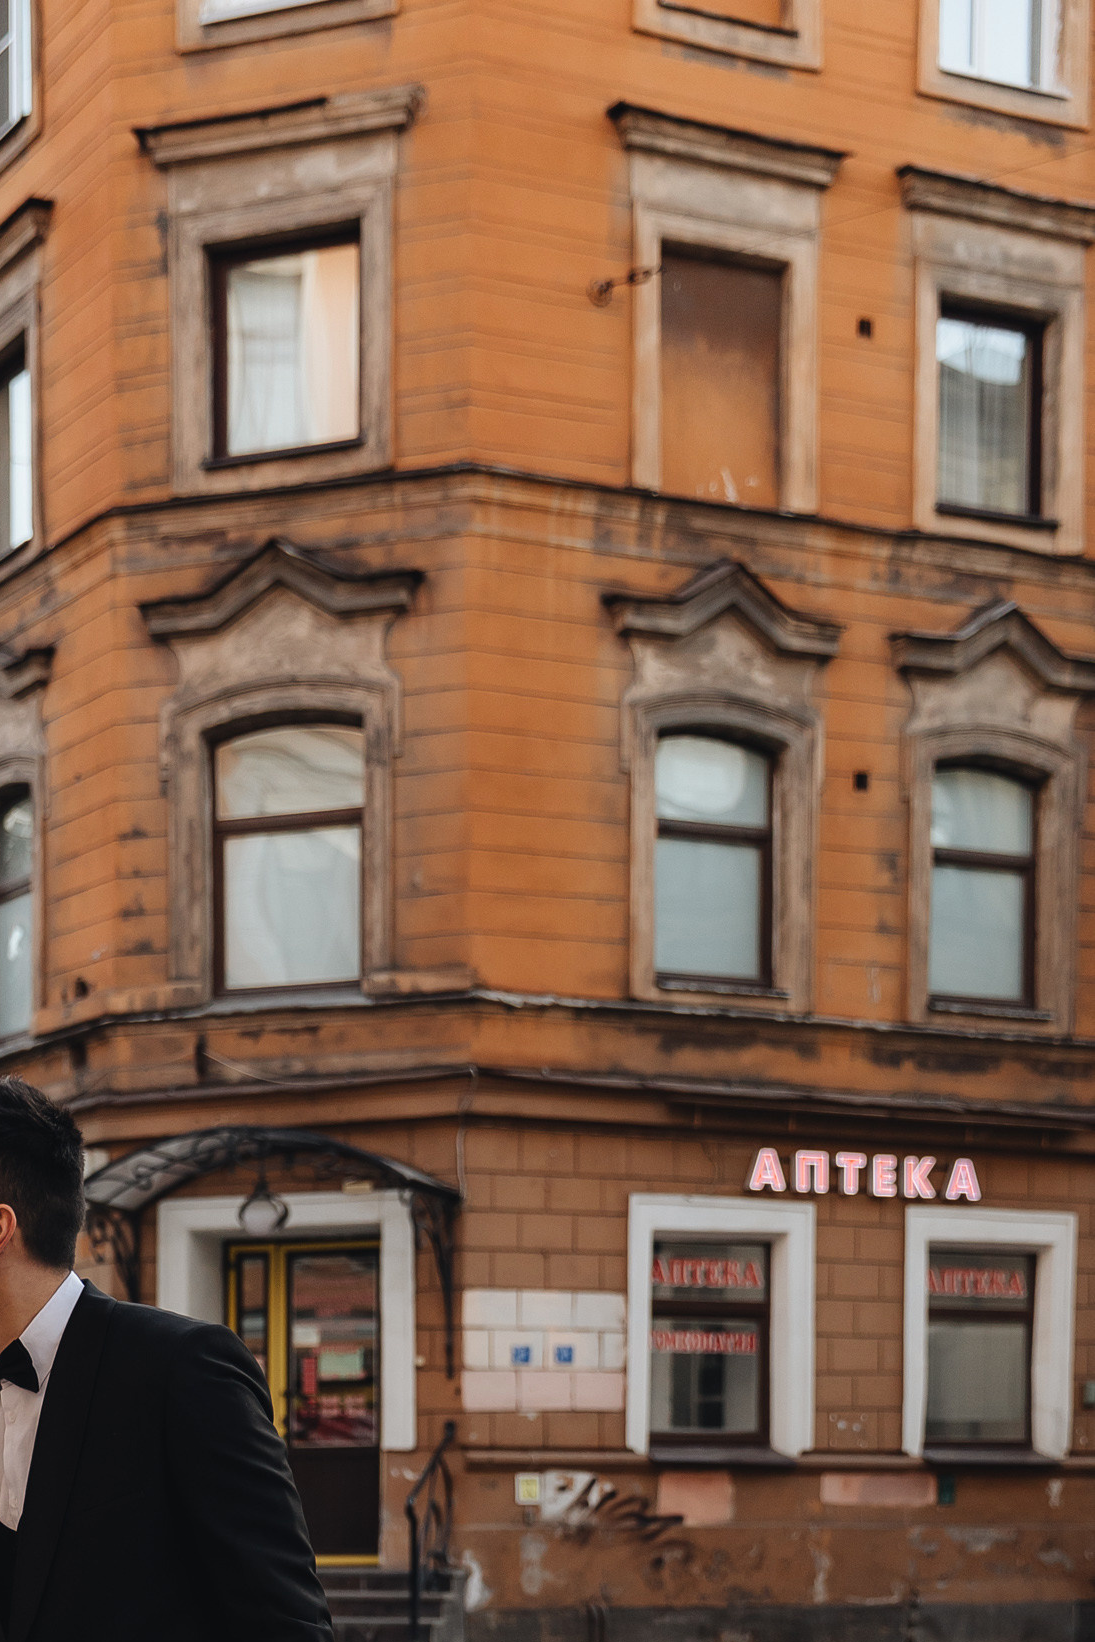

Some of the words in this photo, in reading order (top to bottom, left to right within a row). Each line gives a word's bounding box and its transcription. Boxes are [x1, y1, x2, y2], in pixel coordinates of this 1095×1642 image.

[749, 1147, 982, 1201] АПТЕКА
[652, 1257, 762, 1288] АПТЕКА
[651, 1331, 757, 1353] ОМЕОПАТИЯ
